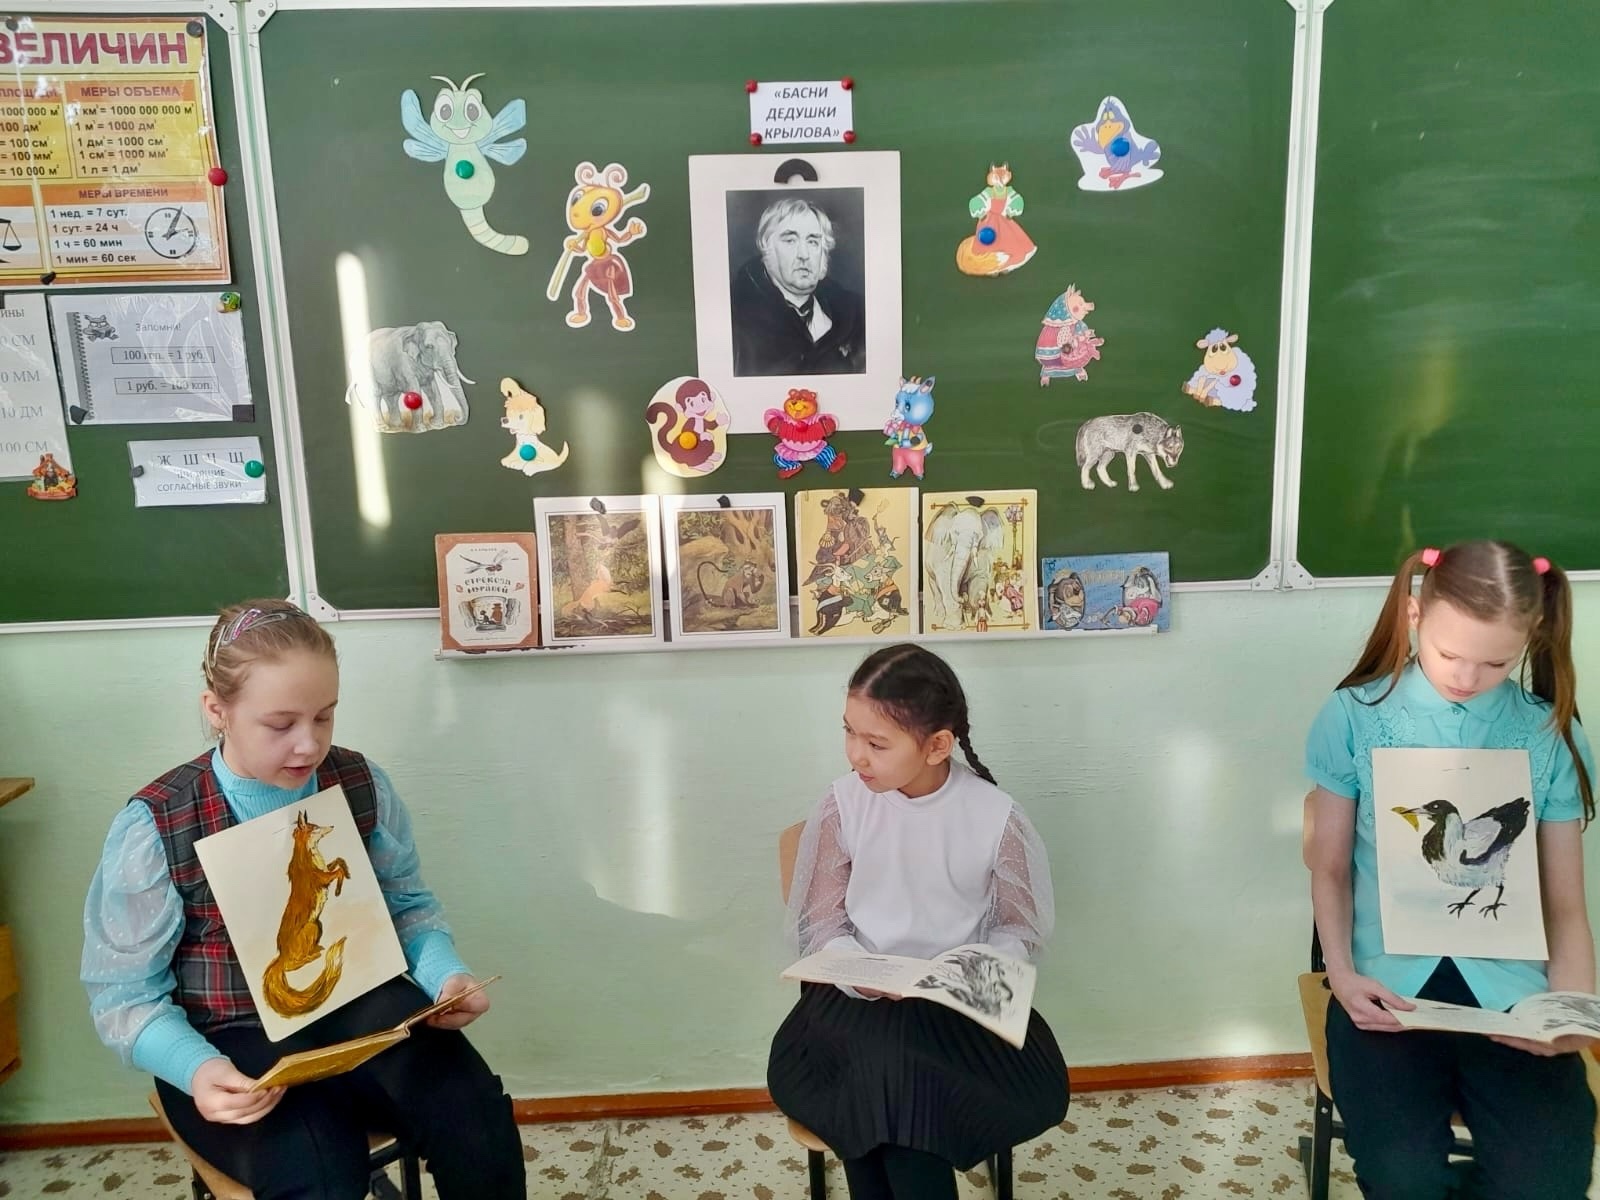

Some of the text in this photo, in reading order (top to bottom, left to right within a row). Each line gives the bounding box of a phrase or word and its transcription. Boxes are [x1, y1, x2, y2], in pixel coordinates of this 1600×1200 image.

[0, 88, 57, 98] ЛОЩДИ
[80, 86, 181, 97] МЕРЫ ОБЪЕМА
[774, 87, 828, 99] «БАСНИ
[27, 106, 47, 116] 000
[111, 105, 136, 115] 1000
[139, 105, 159, 115] 000
[162, 105, 181, 115] 000
[765, 106, 837, 121] ДЕДУШКИ
[75, 121, 81, 131] 1
[108, 120, 135, 131] 1000
[764, 126, 840, 139] КРЫЛОВА»
[10, 138, 29, 148] 100
[77, 136, 83, 147] 1
[118, 136, 144, 146] 1000
[12, 151, 31, 161] 100
[80, 150, 85, 160] 1
[119, 149, 145, 159] 1000
[10, 165, 23, 176] 10
[26, 165, 45, 176] 000
[82, 165, 87, 175] 1
[112, 164, 118, 174] 1
[79, 188, 169, 199] МЕРЫ ВРЕМЕНИ
[51, 209, 56, 218] 1
[60, 209, 84, 219] нед.
[98, 208, 103, 217] 7
[106, 208, 128, 219] сут.
[53, 224, 58, 233] 1
[62, 224, 83, 235] сут.
[95, 223, 109, 233] 24
[111, 223, 119, 232] ч
[55, 239, 60, 248] 1
[63, 240, 71, 248] ч
[83, 238, 96, 248] 60
[99, 239, 122, 248] мин
[57, 255, 62, 264] 1
[66, 256, 88, 264] мин
[101, 253, 114, 263] 60
[117, 254, 136, 263] сек
[135, 323, 181, 332] Запомни!
[124, 350, 141, 360] 100
[177, 350, 182, 360] 1
[13, 370, 40, 383] ММ
[127, 381, 132, 391] 1
[136, 380, 158, 392] руб.
[157, 455, 171, 465] Ж
[183, 453, 199, 465] Ш
[157, 481, 242, 492] СОГЛАСНЫЕ ЗВУКИ
